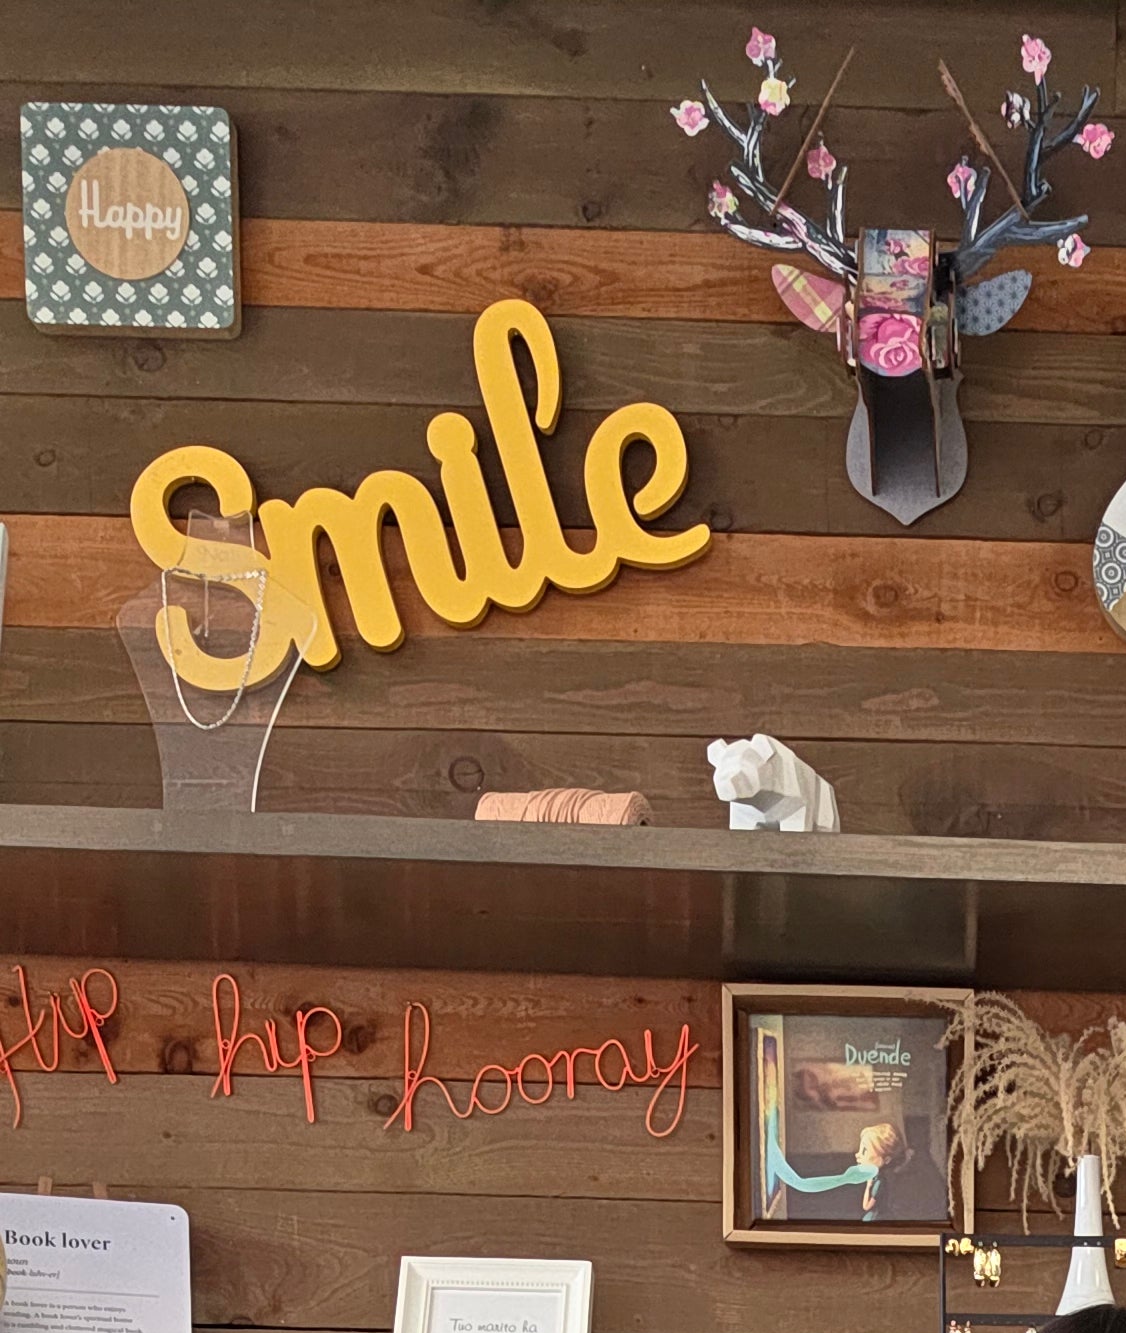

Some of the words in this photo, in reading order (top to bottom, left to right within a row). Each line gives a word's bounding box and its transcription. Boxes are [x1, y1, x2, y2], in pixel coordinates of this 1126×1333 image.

[78, 179, 184, 241] Happy
[130, 298, 712, 694] Smile
[384, 1000, 700, 1138] hooray
[845, 1038, 911, 1067] Duende
[5, 1230, 56, 1247] Book
[62, 1232, 111, 1251] lover
[449, 1318, 473, 1332] Tuo
[478, 1322, 517, 1333] marito
[522, 1319, 538, 1333] ha
